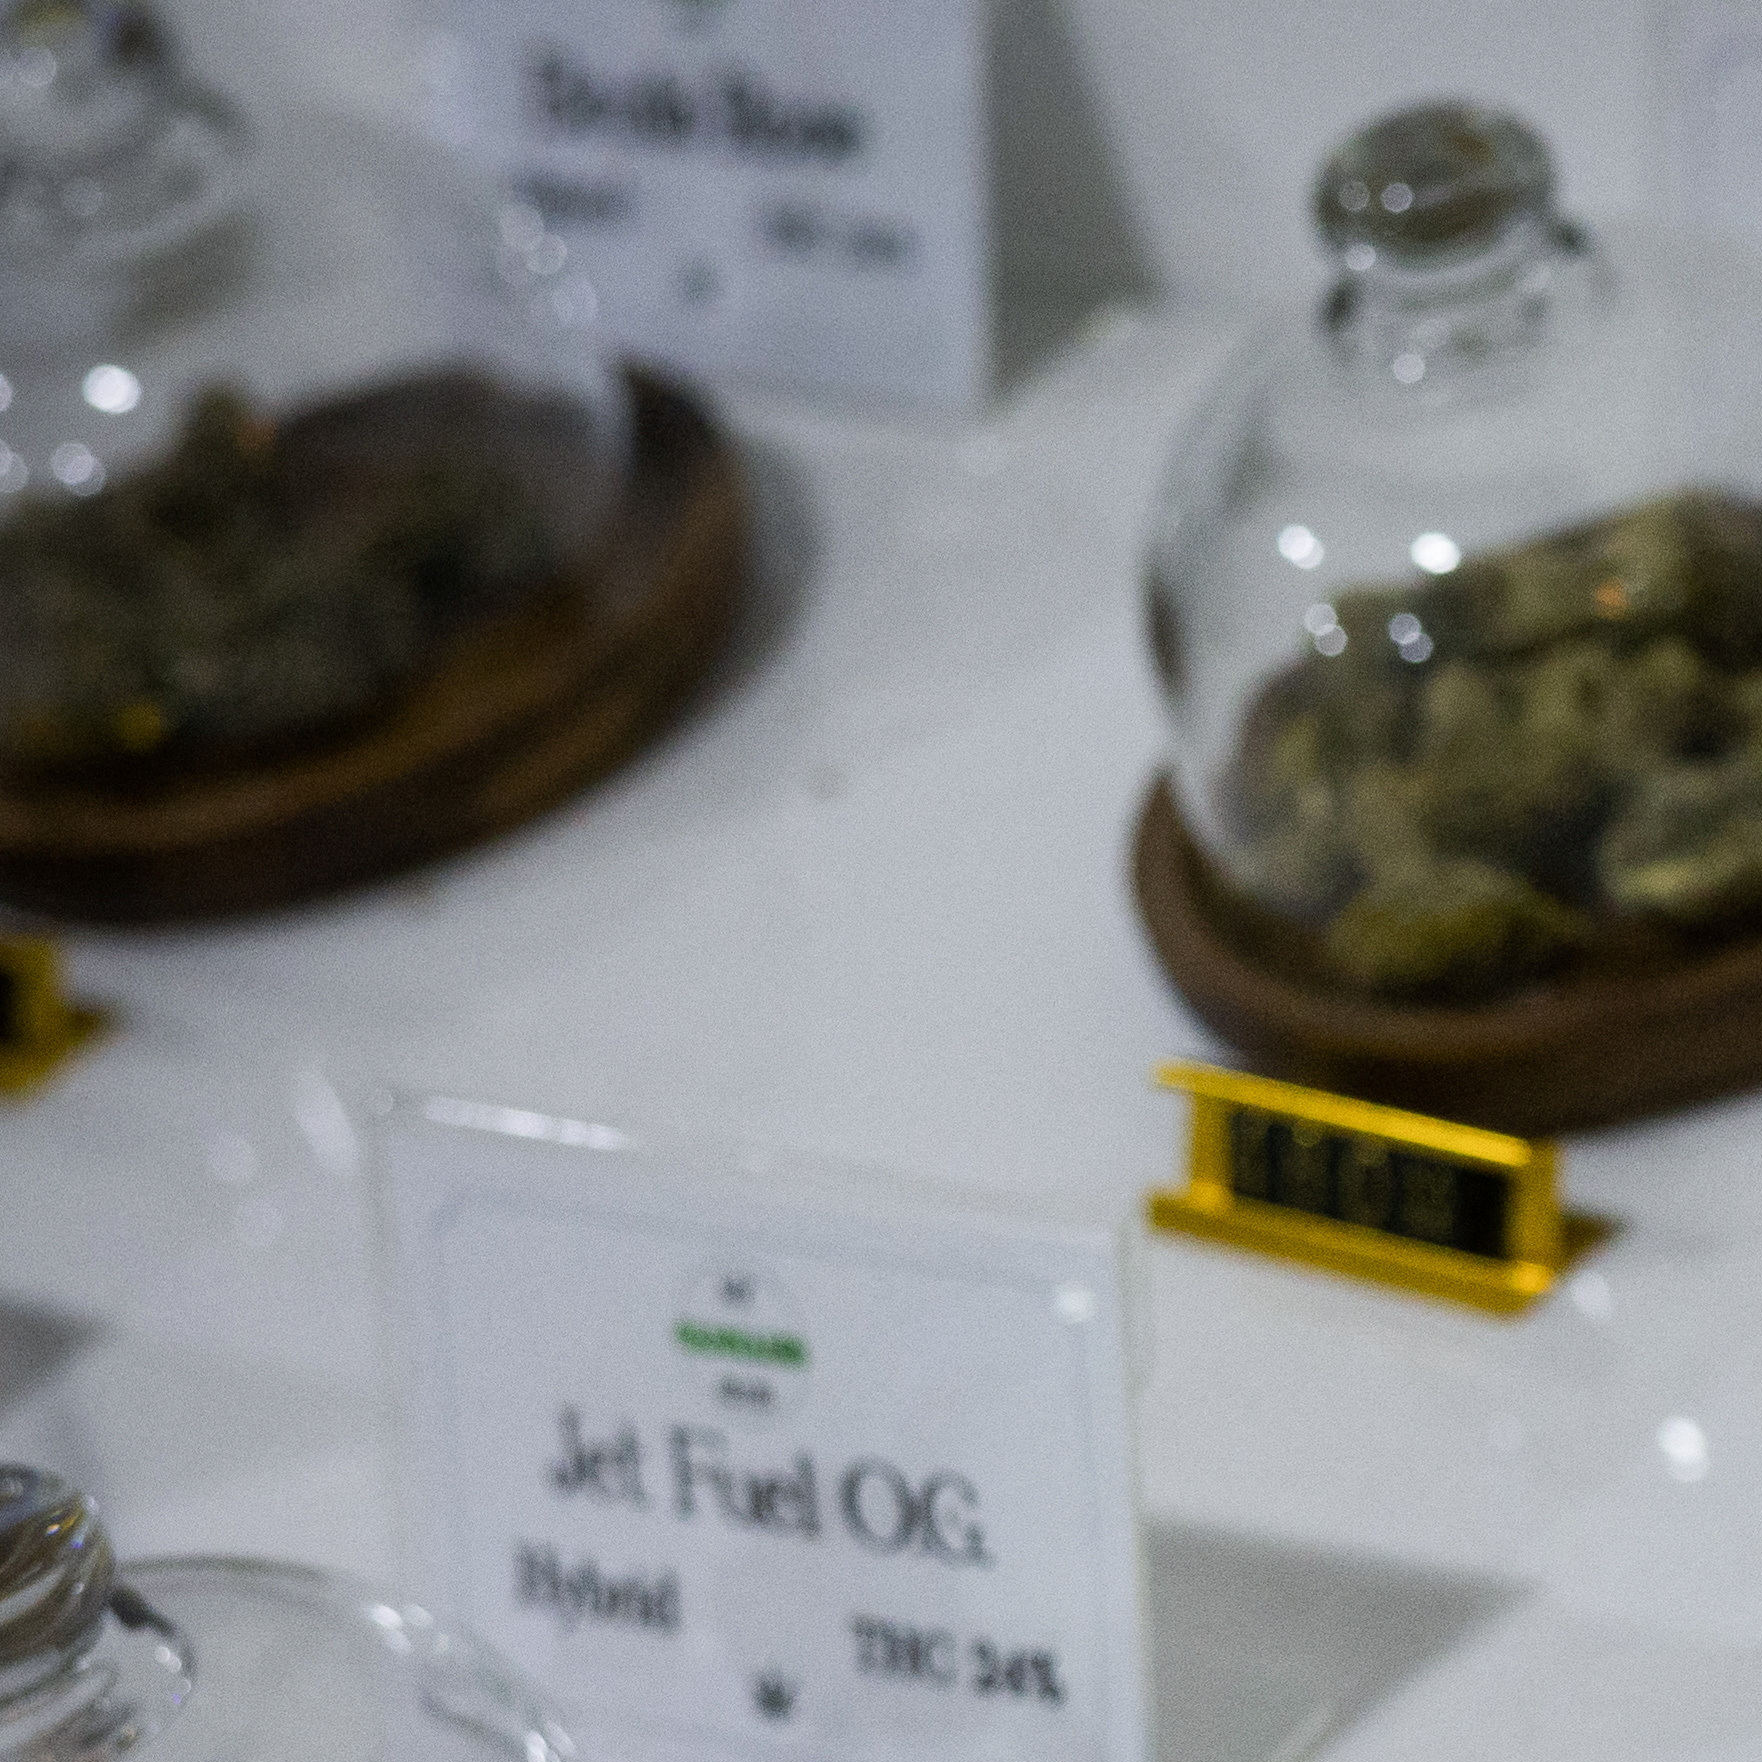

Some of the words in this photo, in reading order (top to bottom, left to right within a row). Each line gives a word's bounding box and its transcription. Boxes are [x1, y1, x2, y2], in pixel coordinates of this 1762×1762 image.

[551, 1402, 649, 1508] Jet
[670, 1422, 822, 1540] Fuel
[838, 1456, 992, 1567] OG
[850, 1613, 959, 1686] THC
